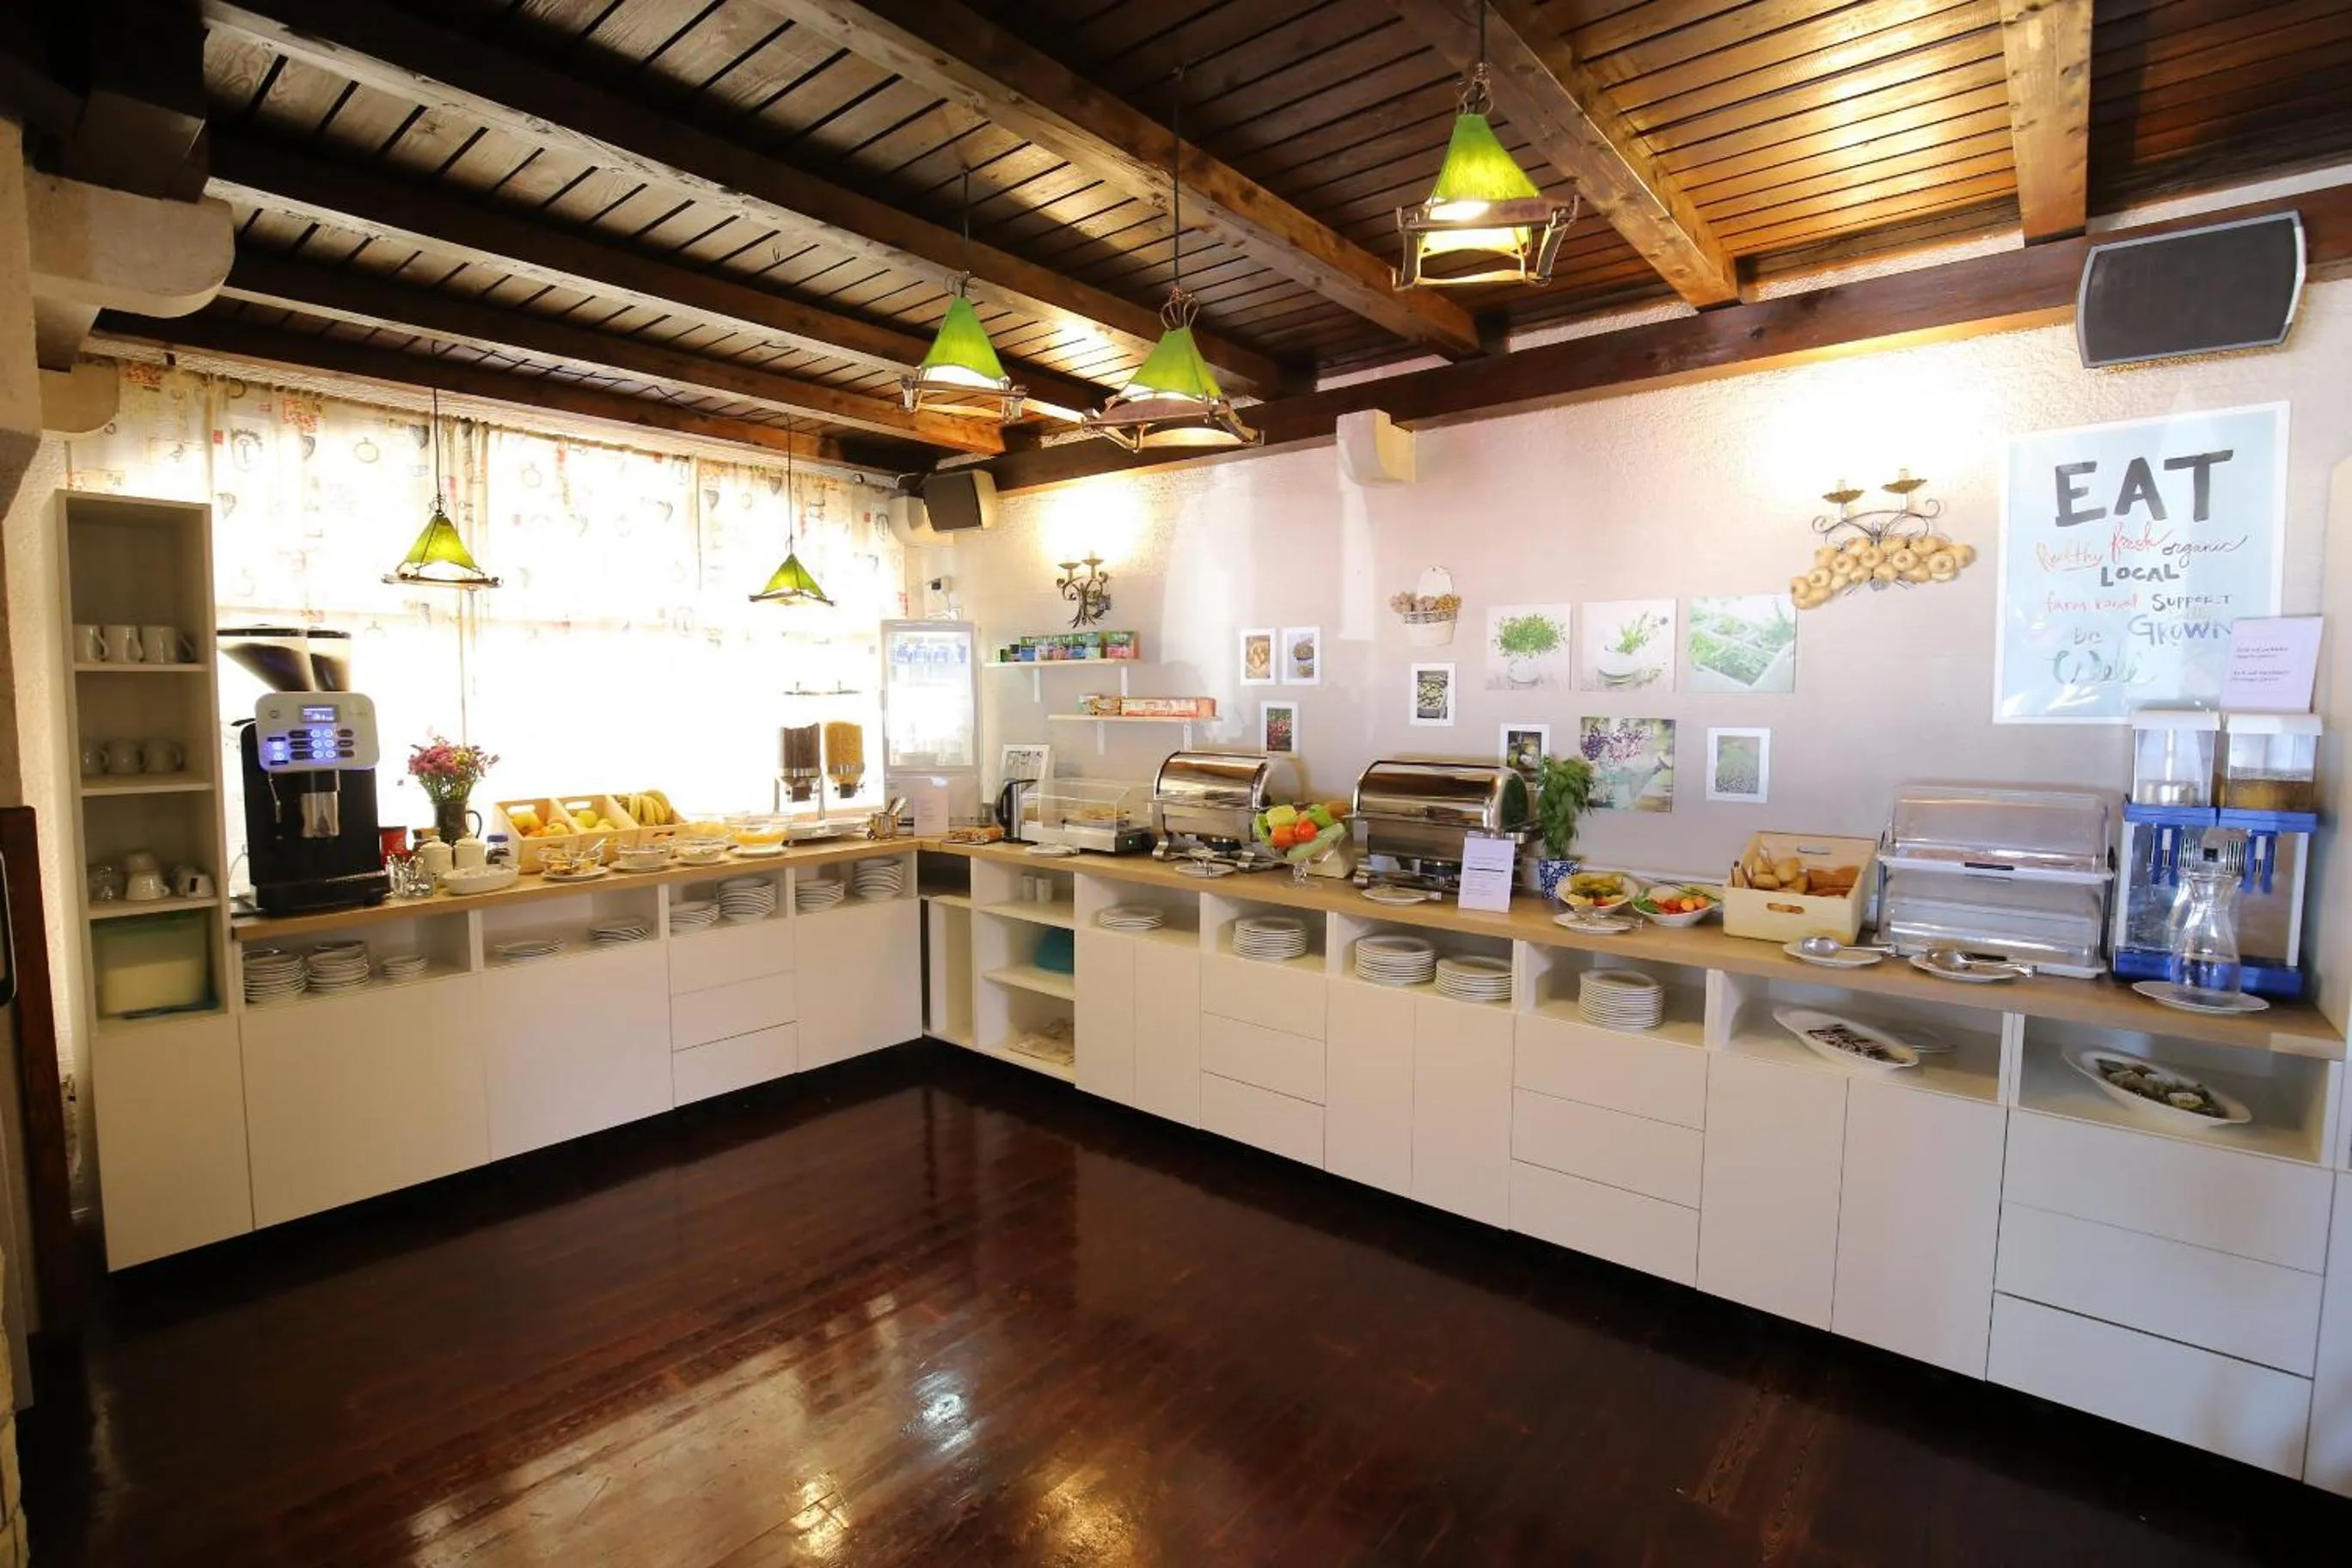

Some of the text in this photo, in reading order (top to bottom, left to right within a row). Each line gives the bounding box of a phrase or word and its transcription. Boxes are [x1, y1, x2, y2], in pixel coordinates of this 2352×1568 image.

[2055, 449, 2233, 528] EAT
[2037, 519, 2248, 571] healthy fresh organic
[2101, 564, 2180, 587] LOCAL
